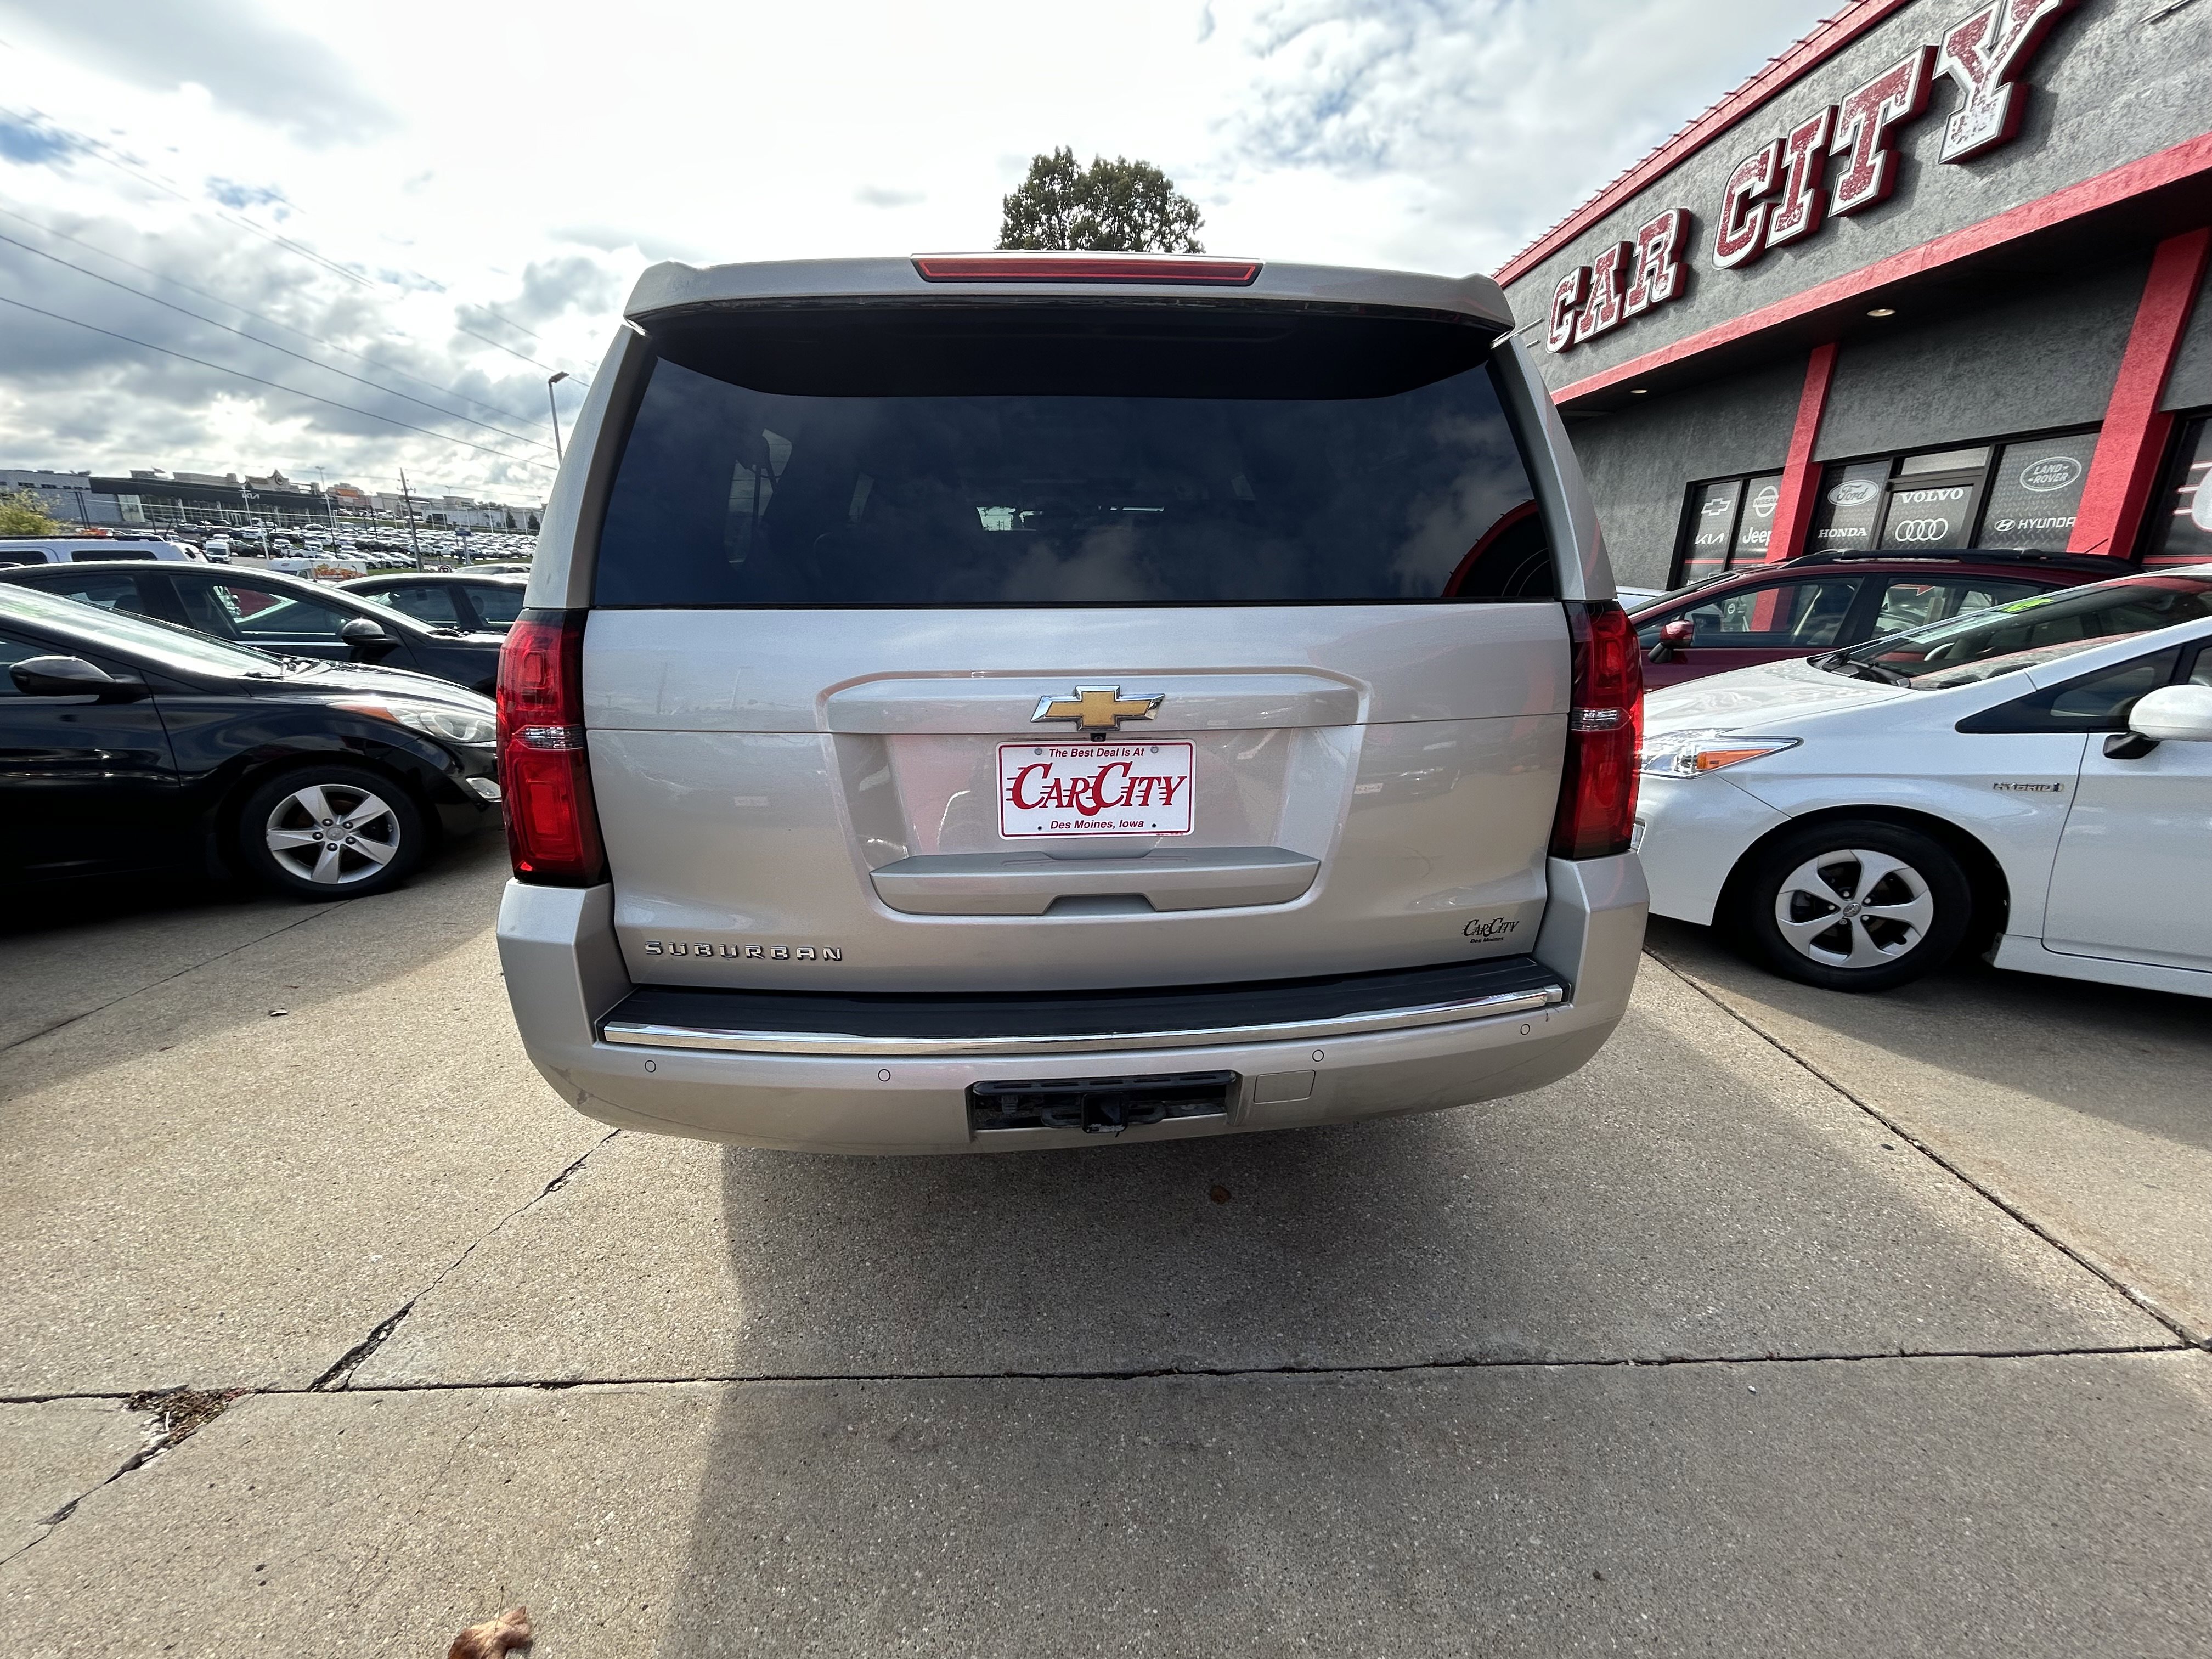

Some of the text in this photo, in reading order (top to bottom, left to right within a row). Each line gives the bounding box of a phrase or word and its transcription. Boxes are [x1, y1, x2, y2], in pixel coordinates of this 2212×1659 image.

[1545, 0, 2079, 354] CAR CITY
[1837, 484, 1869, 502] Ford
[1900, 488, 1964, 504] VOLVO
[2017, 516, 2077, 529] HYUNDA
[1818, 527, 1867, 538] HONDA
[1695, 533, 1724, 545] KIA
[1049, 747, 1145, 758] The Best Deal Is At
[1993, 783, 2052, 792] HYBRID
[1051, 819, 1144, 830] Des Moines, Iowa
[645, 940, 842, 961] SUBURBAN
